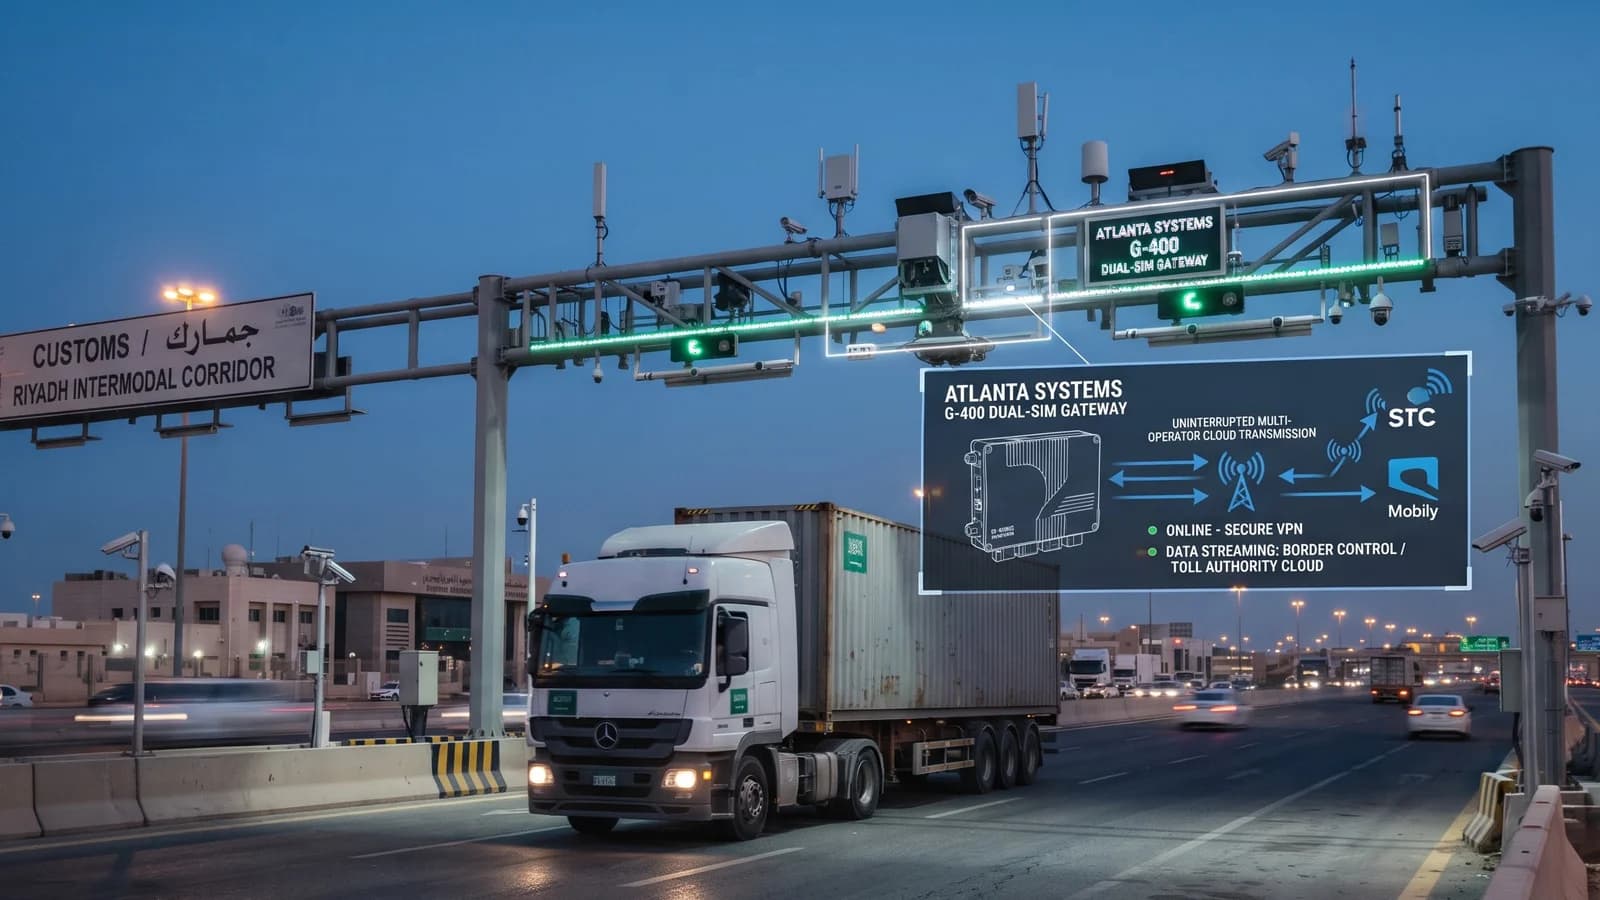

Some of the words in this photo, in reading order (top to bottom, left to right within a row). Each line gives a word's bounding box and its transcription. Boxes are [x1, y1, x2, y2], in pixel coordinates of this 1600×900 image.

[1096, 222, 1152, 240] ATLANTA
[1154, 215, 1214, 234] SYSTEMS
[1129, 236, 1180, 258] G-400
[1101, 259, 1154, 276] DUAL-SIM
[1156, 254, 1209, 271] GATEWAY
[33, 332, 130, 368] CUSTOMS
[142, 329, 149, 356] /
[166, 318, 260, 355] جمارك
[13, 380, 68, 406] RIYADH
[73, 365, 177, 400] INTERMODAL
[182, 356, 276, 387] CORRIDOR
